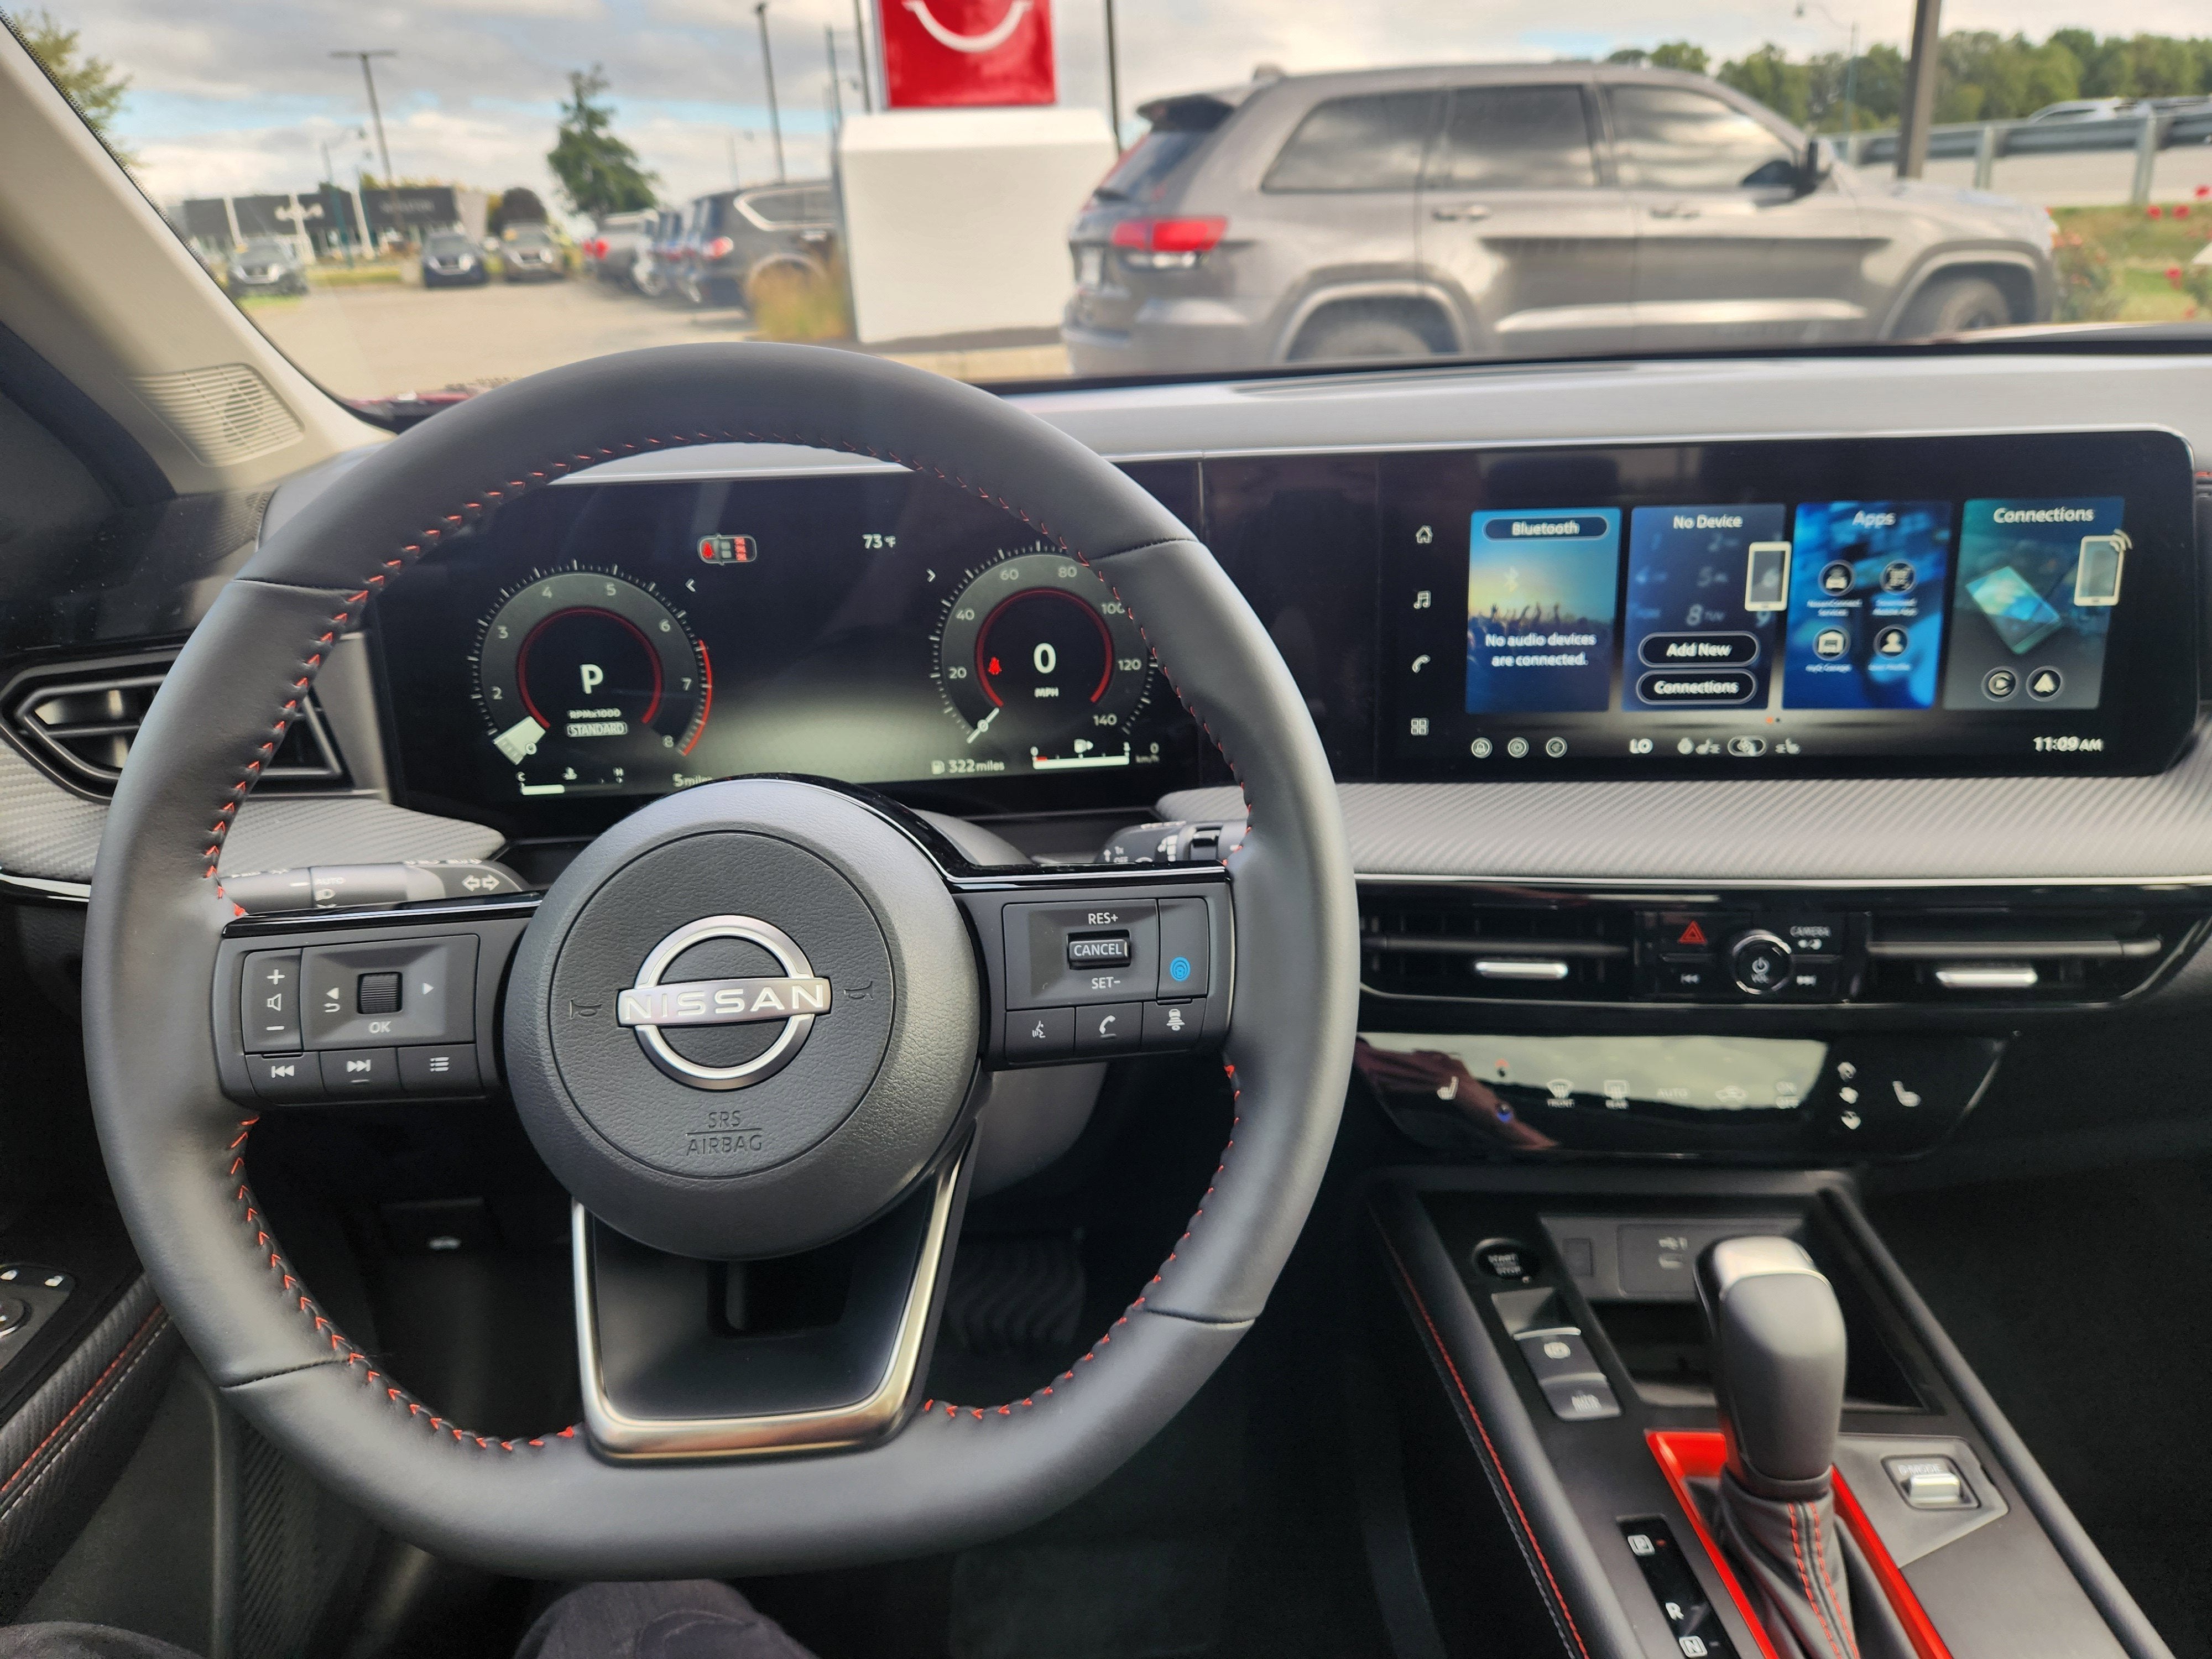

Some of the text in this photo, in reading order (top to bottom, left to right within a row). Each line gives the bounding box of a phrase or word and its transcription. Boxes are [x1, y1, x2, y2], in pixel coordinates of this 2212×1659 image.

[1673, 514, 1743, 529] No Device
[1852, 511, 1895, 529] Apps
[1994, 507, 2094, 524] Connections
[1511, 520, 1579, 536] Bluetooth
[863, 534, 883, 548] 73
[1000, 569, 1019, 581] 60
[1058, 567, 1077, 578] 80
[542, 586, 552, 598] 4
[607, 584, 616, 596] 5
[956, 609, 974, 621] 40
[1686, 604, 1703, 626] 8
[660, 620, 671, 632] 6
[499, 627, 508, 639] 3
[1485, 632, 1597, 646] No audio devices
[1667, 643, 1732, 656] Add New
[1034, 643, 1056, 673] 0
[1118, 659, 1141, 670] 120
[1491, 652, 1588, 667] are connected.
[580, 664, 603, 693] P
[950, 667, 967, 679] 20
[681, 679, 691, 690] 7
[1654, 681, 1739, 695] Connections
[492, 687, 502, 700] 2
[1035, 688, 1058, 698] MPH
[1093, 714, 1117, 726] 140
[570, 723, 624, 735] STANDARD
[664, 735, 673, 748] 8
[1150, 742, 1160, 754] 0
[1629, 738, 1653, 754] LO
[2033, 736, 2103, 752] 11:09 AM
[315, 877, 346, 886] AUTO
[1088, 912, 1118, 925] RES+
[1790, 926, 1831, 937] CAMERA
[1074, 943, 1122, 956] CANCEL
[1091, 977, 1121, 989] SET-
[624, 984, 823, 1020] NISSAN
[369, 1022, 391, 1034] OK
[708, 1110, 741, 1130] SRS
[686, 1135, 763, 1157] AIRBAG
[1666, 1603, 1684, 1620] R
